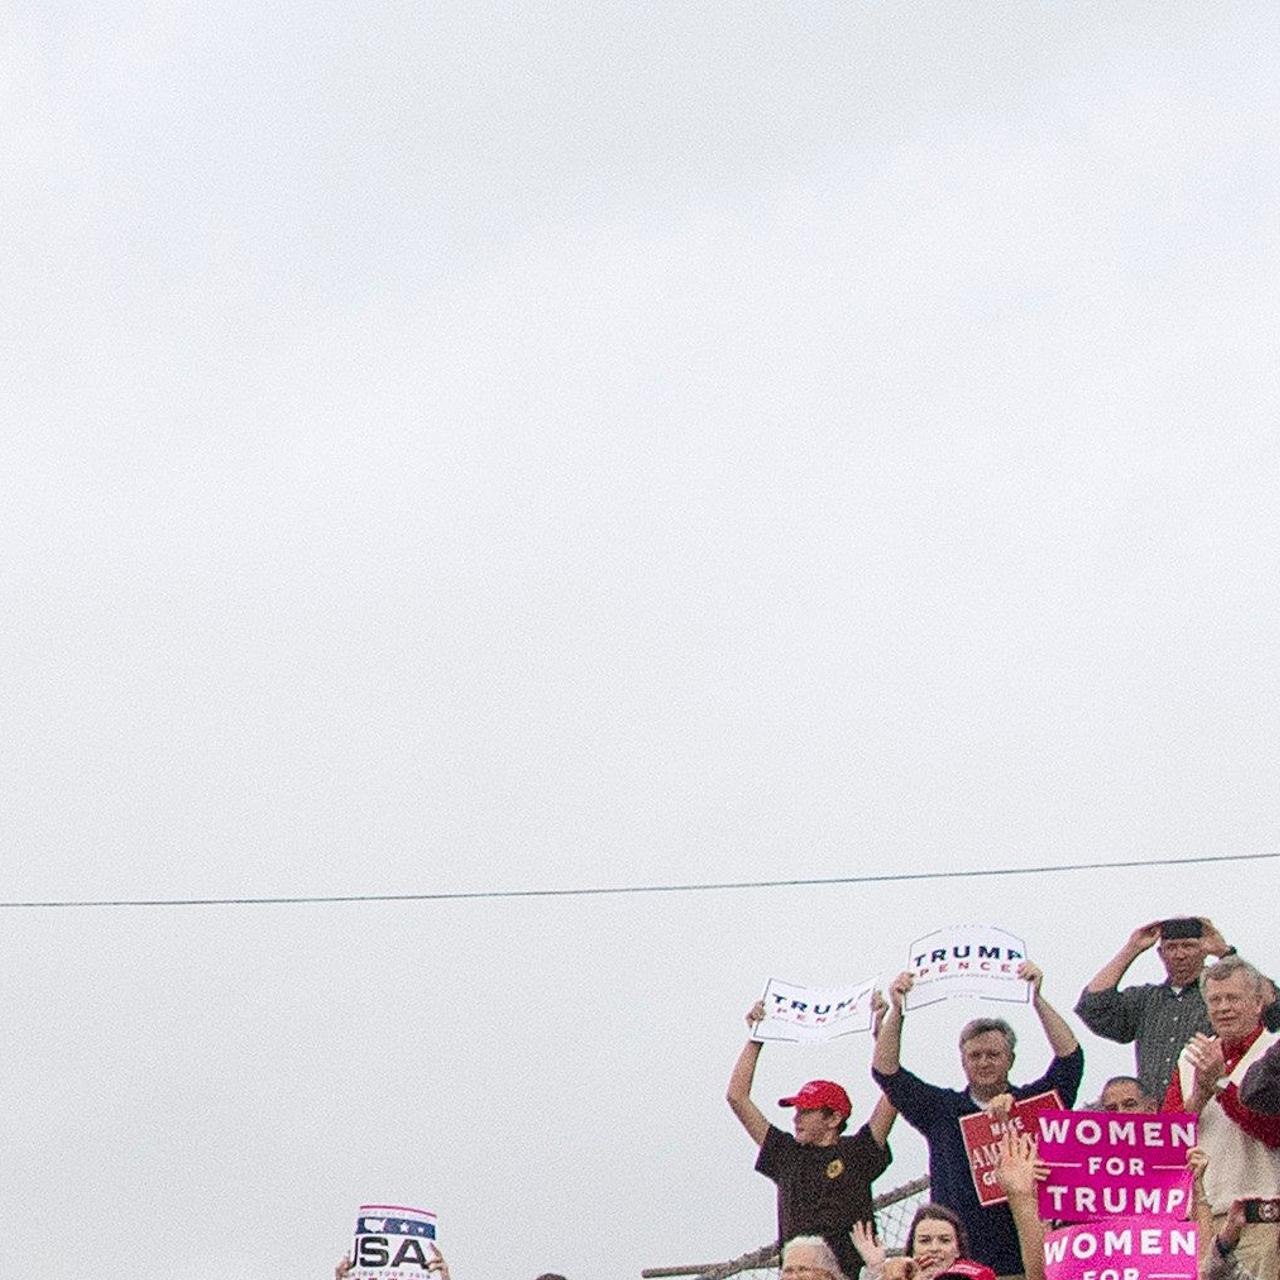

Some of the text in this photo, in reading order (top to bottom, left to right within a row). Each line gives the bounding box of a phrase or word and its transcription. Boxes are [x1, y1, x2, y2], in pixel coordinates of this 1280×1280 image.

[914, 945, 1023, 966] TRUMP
[920, 961, 1011, 977] PENCE
[1039, 1117, 1197, 1148] WOMEN
[1088, 1157, 1145, 1176] FOR
[1046, 1185, 1185, 1214] TRUMP
[1043, 1229, 1196, 1265] WOMEN
